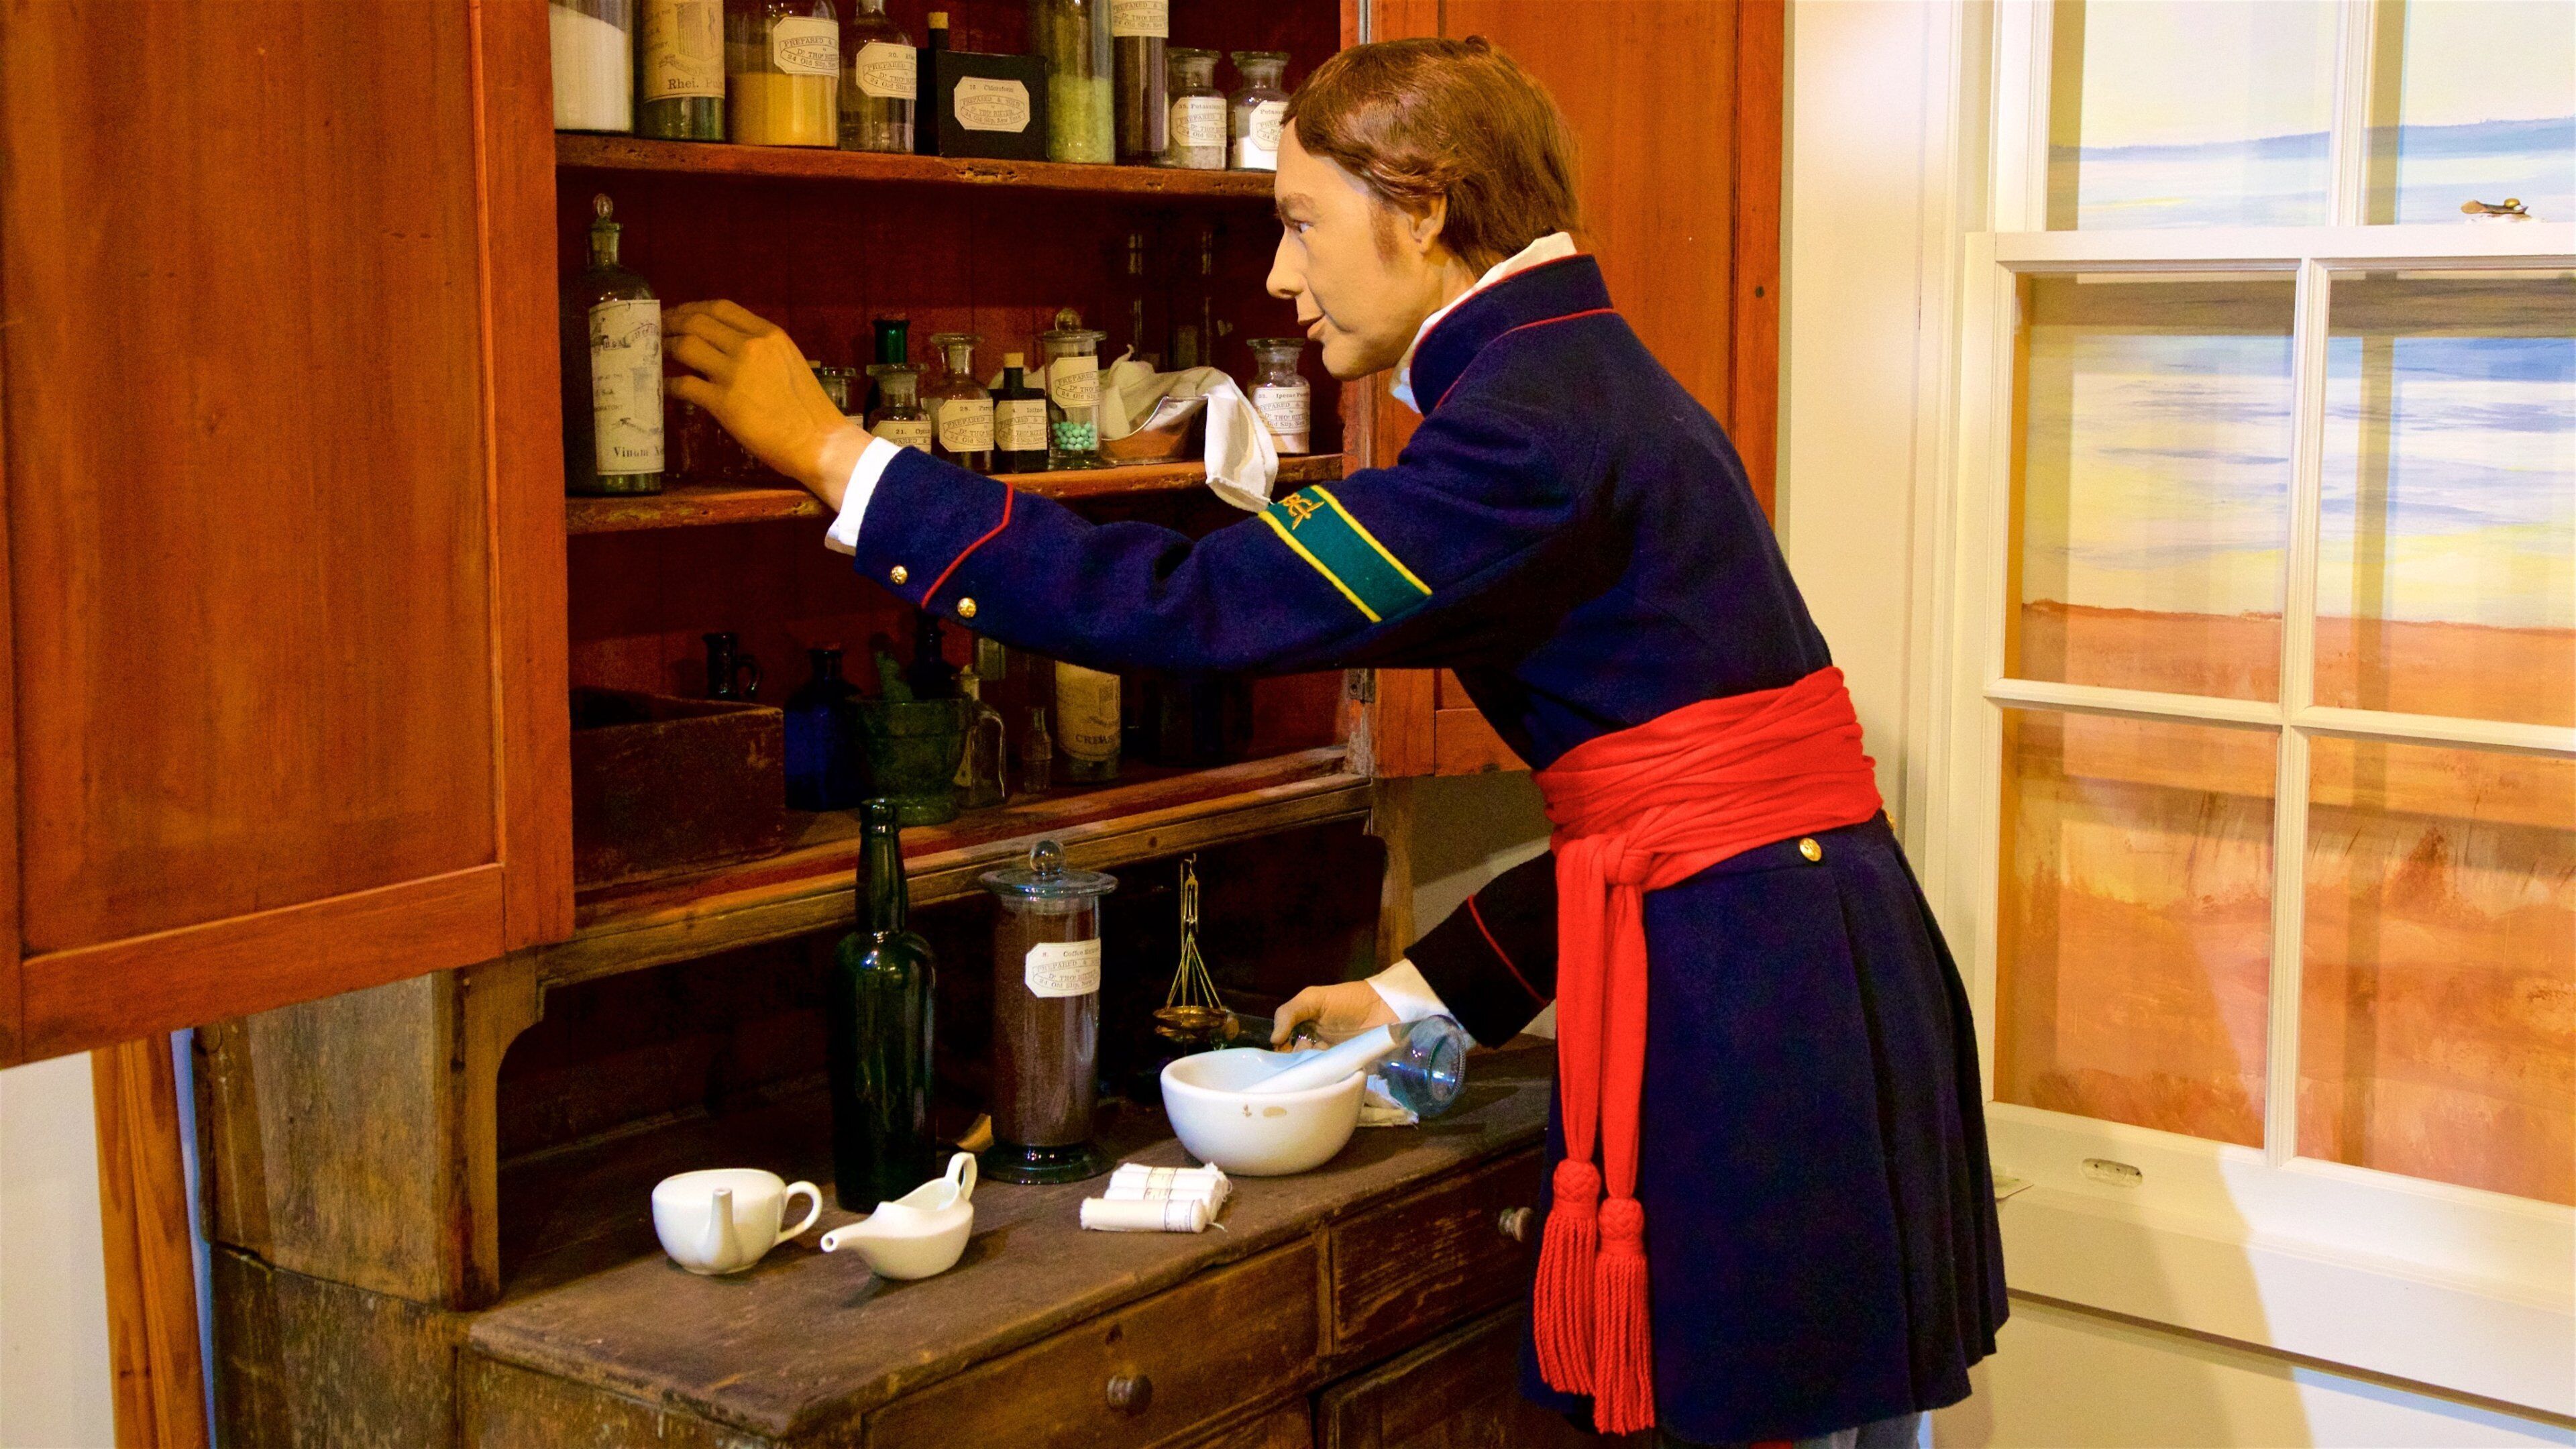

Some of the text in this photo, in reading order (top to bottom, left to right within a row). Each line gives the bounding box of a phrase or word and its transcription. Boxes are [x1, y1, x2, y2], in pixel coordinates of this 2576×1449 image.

[784, 38, 823, 47] PREPARED
[667, 77, 699, 89] Rhei.
[963, 97, 992, 105] PREPARED
[1058, 373, 1093, 385] PREPARED
[947, 417, 985, 428] PREPARED
[613, 447, 649, 458] Vinum
[1038, 961, 1077, 972] PREPARED
